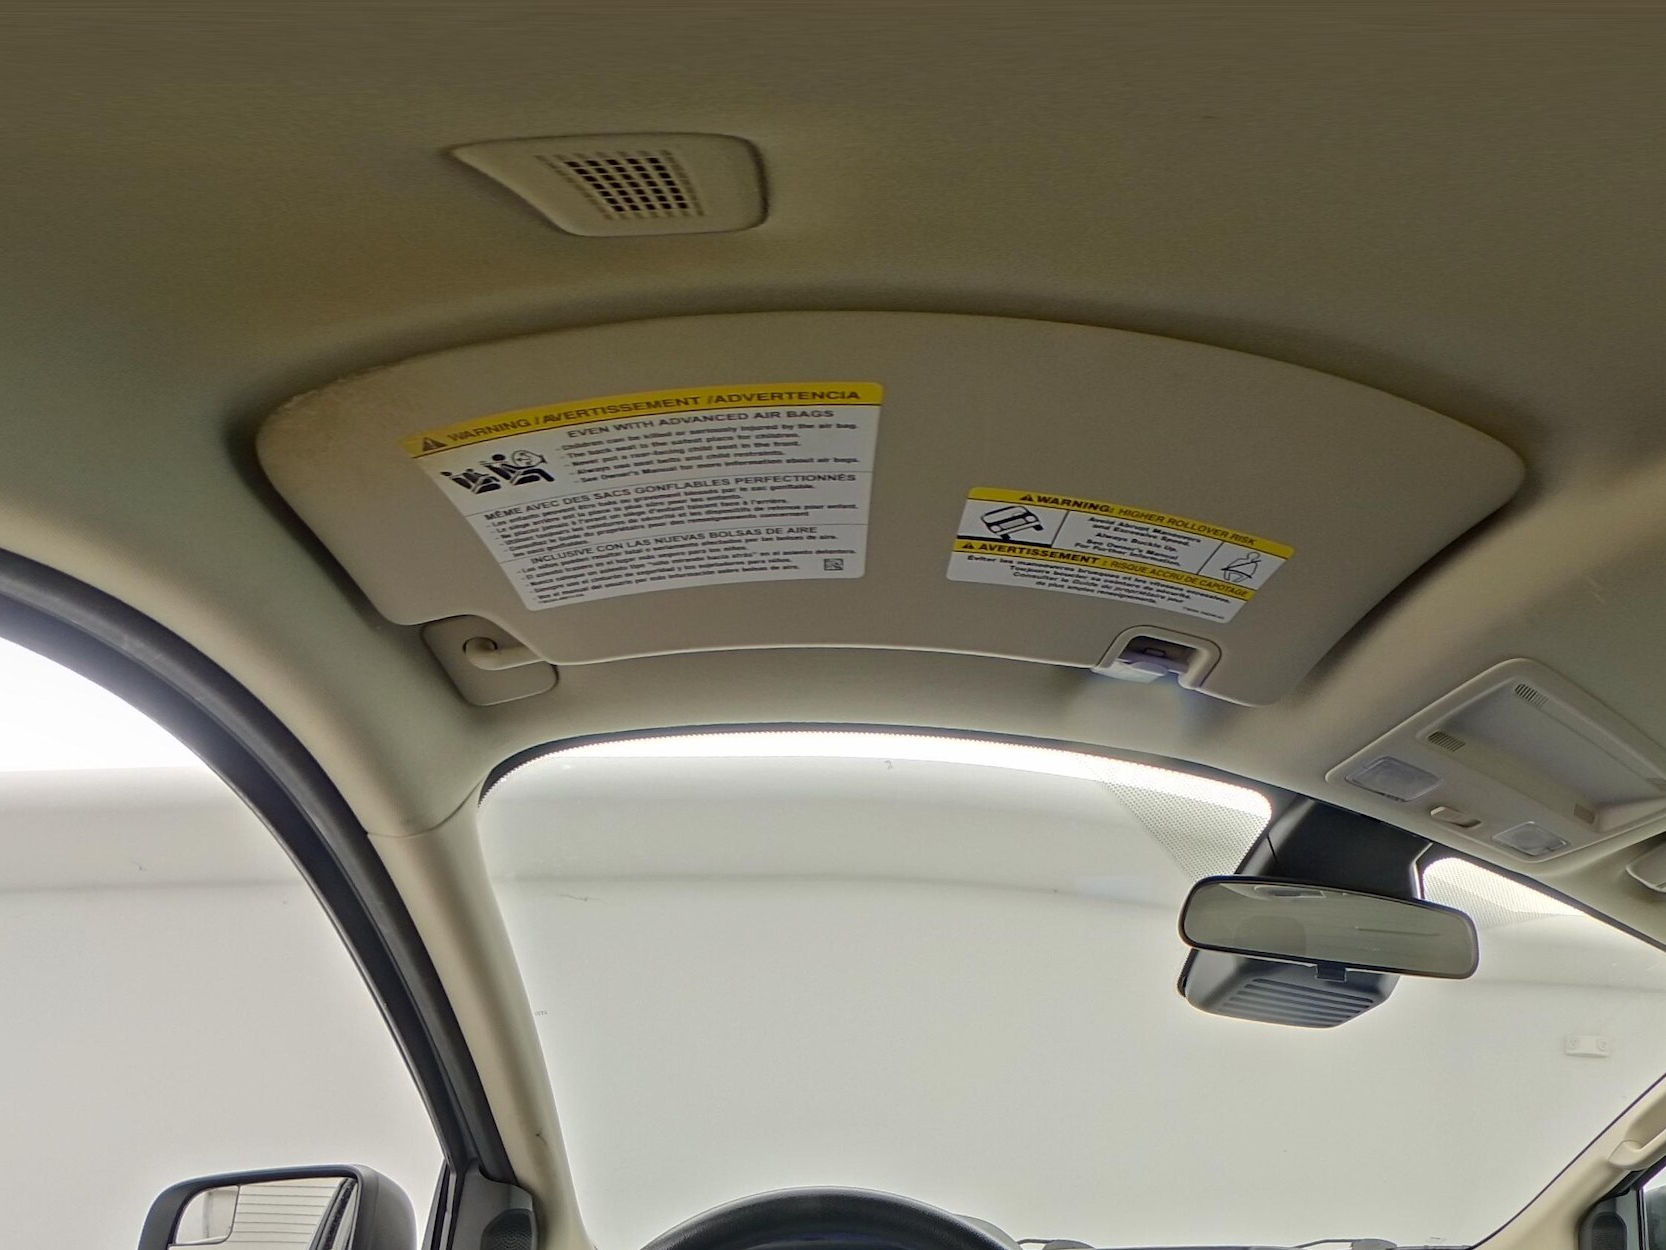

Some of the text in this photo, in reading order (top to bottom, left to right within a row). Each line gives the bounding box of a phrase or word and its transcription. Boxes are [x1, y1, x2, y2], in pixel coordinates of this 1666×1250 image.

[448, 418, 531, 442] WARNING
[568, 410, 834, 438] EVEN WITH ADVANCED AIR BAGS
[485, 473, 856, 520] MÊME AVEC DES SACS GONFLABLES PERFECTIONNÉS
[1038, 496, 1257, 546] WARNING: HIGHER ROLLOVER RISK
[531, 547, 594, 564] INCLUSIVE
[597, 542, 623, 553] CON
[627, 539, 650, 548] LAS
[655, 533, 705, 545] NUEVAS
[709, 529, 762, 539] BOLSAS
[766, 528, 783, 536] DE
[979, 544, 1100, 565] AVERTISSEMENT
[1111, 561, 1146, 574] RISQUE
[1149, 568, 1184, 581] ACCRU
[1188, 576, 1198, 585] DE
[1200, 579, 1248, 598] CAPOTAGE
